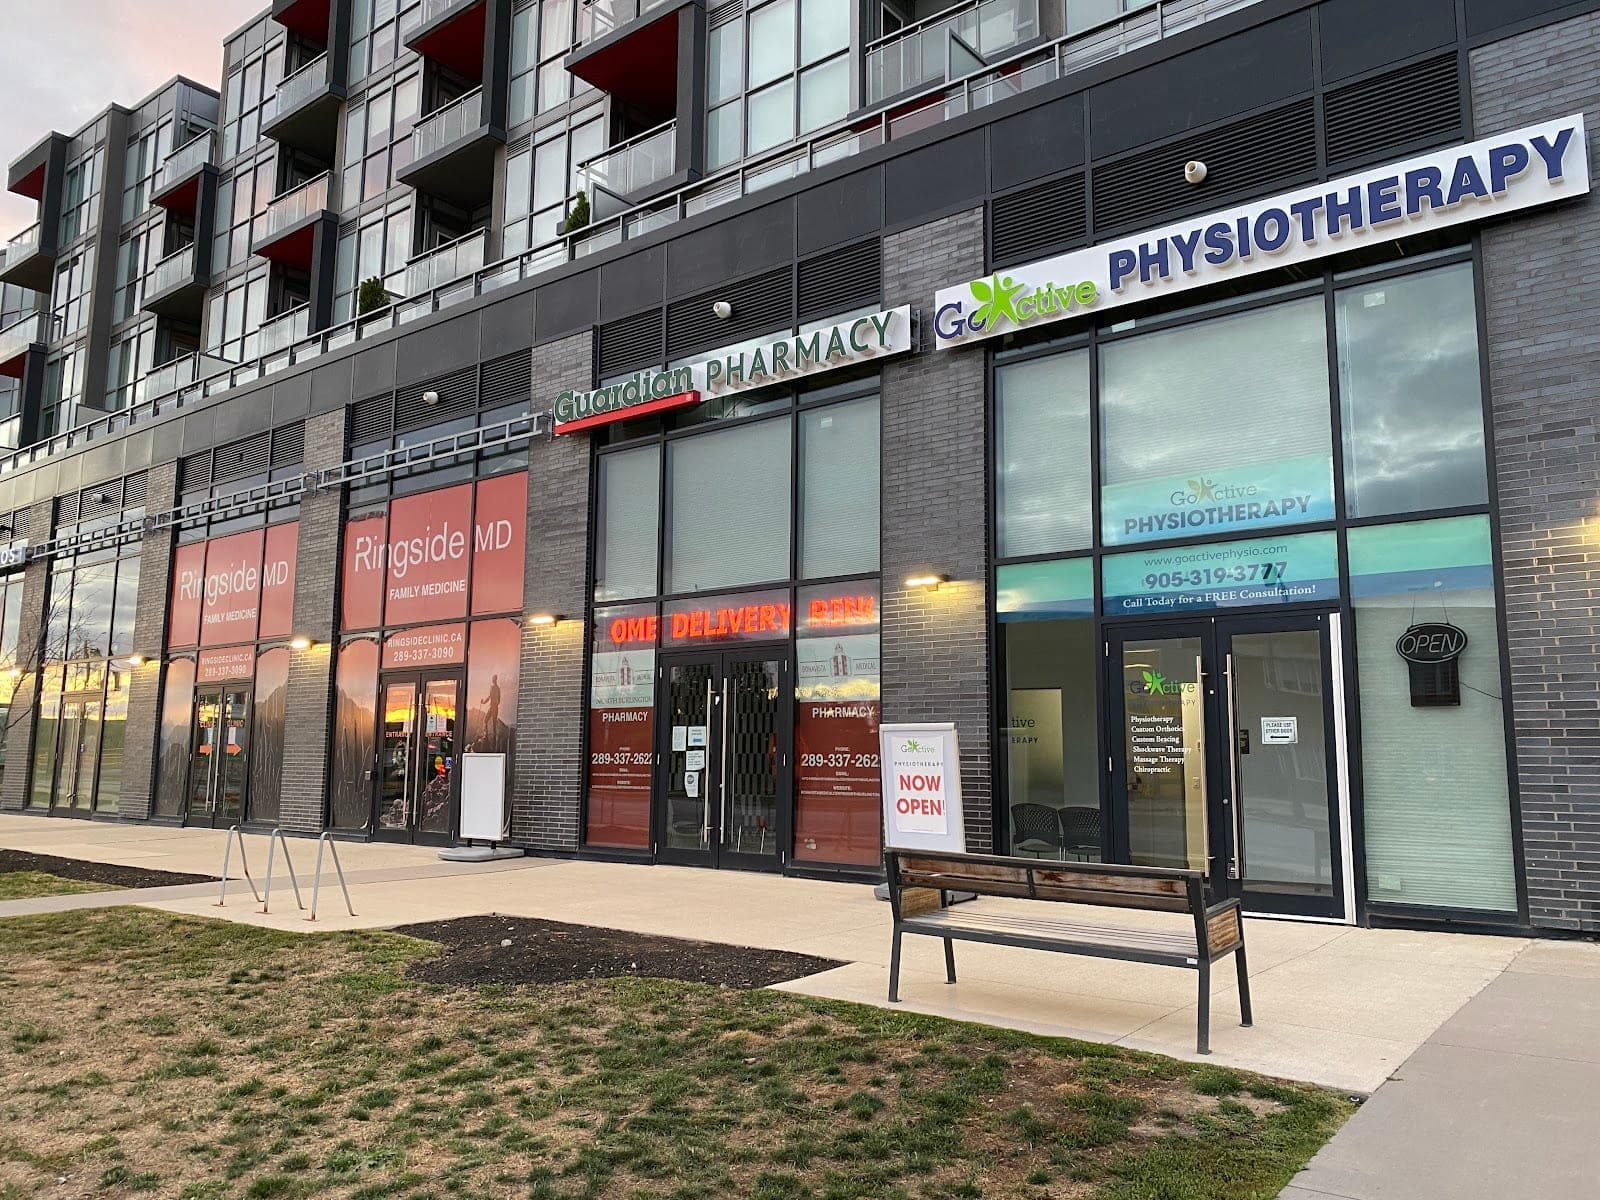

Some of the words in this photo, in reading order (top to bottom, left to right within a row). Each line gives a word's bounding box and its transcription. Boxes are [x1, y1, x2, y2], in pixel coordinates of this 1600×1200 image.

[1107, 127, 1576, 291] PHYSIOTHERAPY
[553, 366, 694, 424] Guardian
[705, 311, 894, 393] PHARMACY
[1124, 495, 1312, 535] PHYSIOTHERAPY
[354, 520, 465, 578] Ringside
[474, 519, 513, 553] MD
[1143, 544, 1288, 567] www.goactivephysio.com
[180, 560, 257, 607] Ringside
[263, 561, 289, 588] MD
[1144, 561, 1288, 589] 905-319-3777
[389, 586, 420, 600] FAMILY
[421, 580, 466, 596] MEDICINE
[1122, 597, 1143, 608] Call
[1145, 595, 1176, 609] Today
[1178, 594, 1194, 605] for
[1196, 595, 1202, 604] a
[1205, 591, 1237, 603] FREE
[1240, 584, 1317, 600] Consultation!
[203, 612, 226, 624] FAMILY
[226, 608, 257, 623] MEDICINE
[609, 615, 656, 644] OME
[671, 603, 790, 638] DELIVERY
[387, 632, 463, 648] RINGSIDECLINIC.CA
[1401, 632, 1458, 654] OPEN
[393, 647, 454, 662] 289-337-3090
[602, 711, 648, 722] PHARMACY
[812, 705, 875, 719] PHARMACY
[1130, 715, 1174, 724] Physiotherapy
[1131, 725, 1155, 733] Custom
[1156, 735, 1180, 744] Bracing
[1132, 745, 1166, 753] Shockwave
[1166, 746, 1192, 755] Therapy
[800, 753, 880, 768] 289-337-262
[1133, 755, 1159, 765] Massage
[1133, 765, 1172, 775] Chiropractic
[899, 774, 941, 791] NOW
[896, 798, 946, 816] OPEN!
